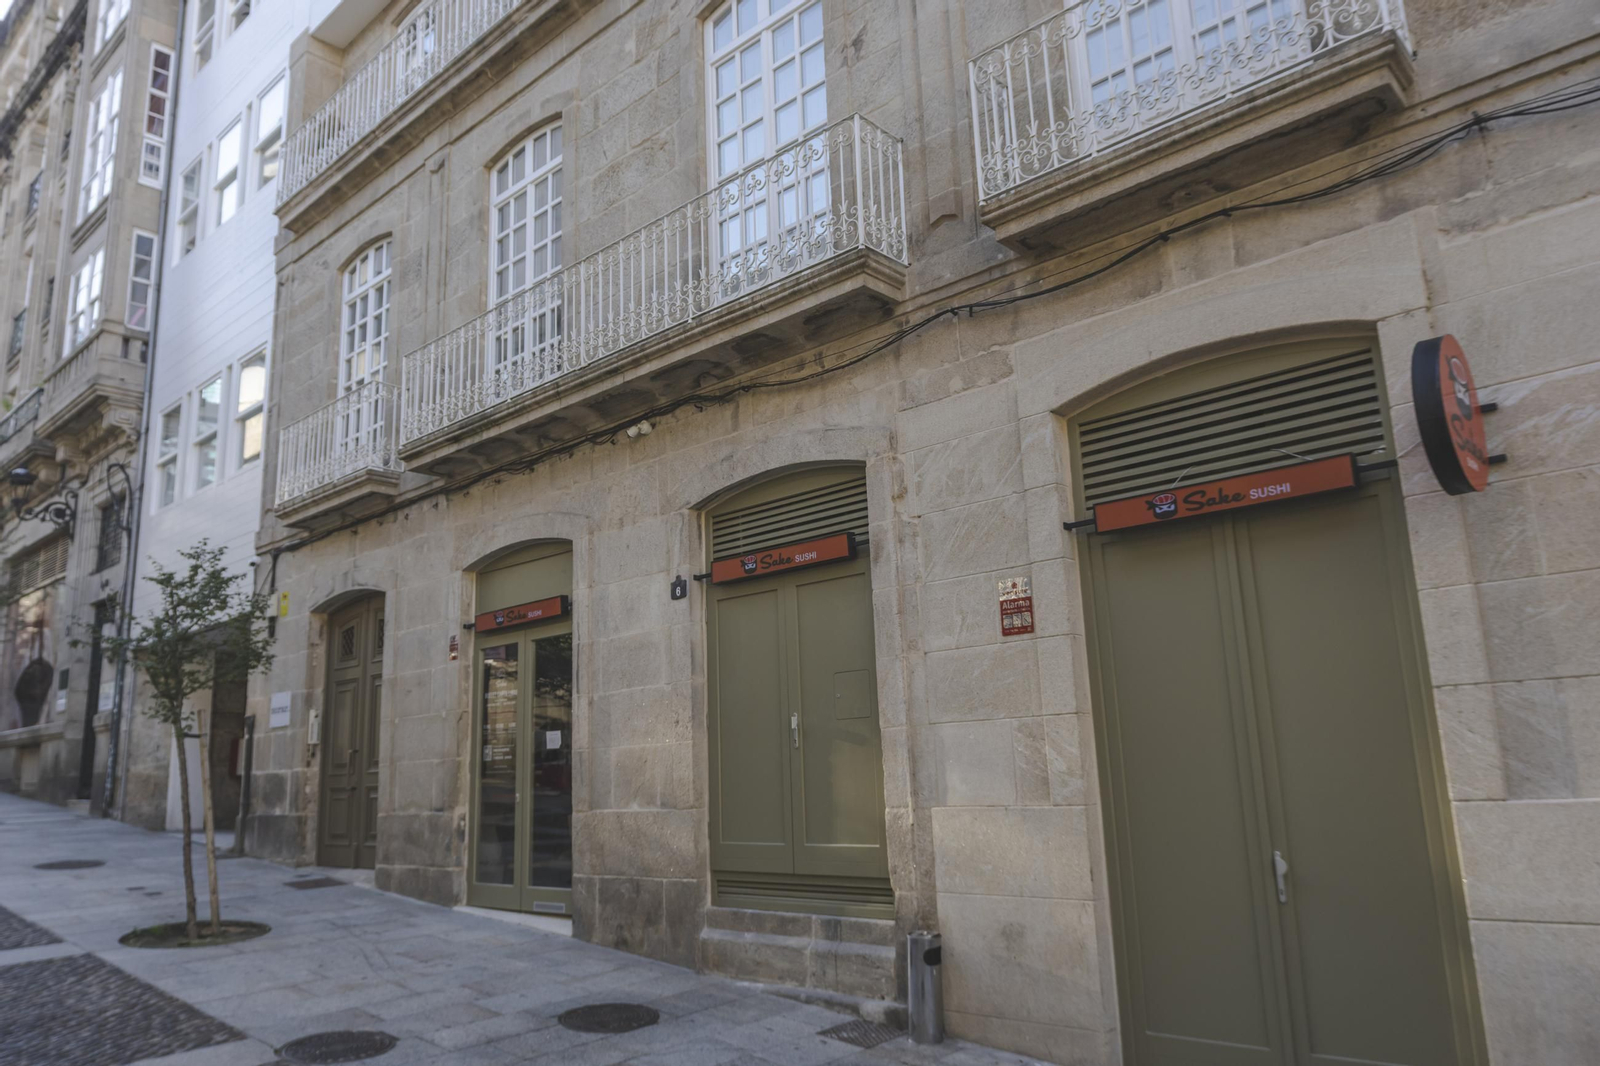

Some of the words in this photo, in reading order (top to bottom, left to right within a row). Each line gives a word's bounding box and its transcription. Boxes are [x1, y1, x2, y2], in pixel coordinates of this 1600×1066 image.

[1183, 487, 1245, 511] Sake
[1249, 482, 1291, 499] SUSHI
[759, 553, 792, 569] Sake
[795, 551, 817, 562] SUSHI
[676, 587, 681, 596] 6
[1002, 599, 1030, 609] Alarma
